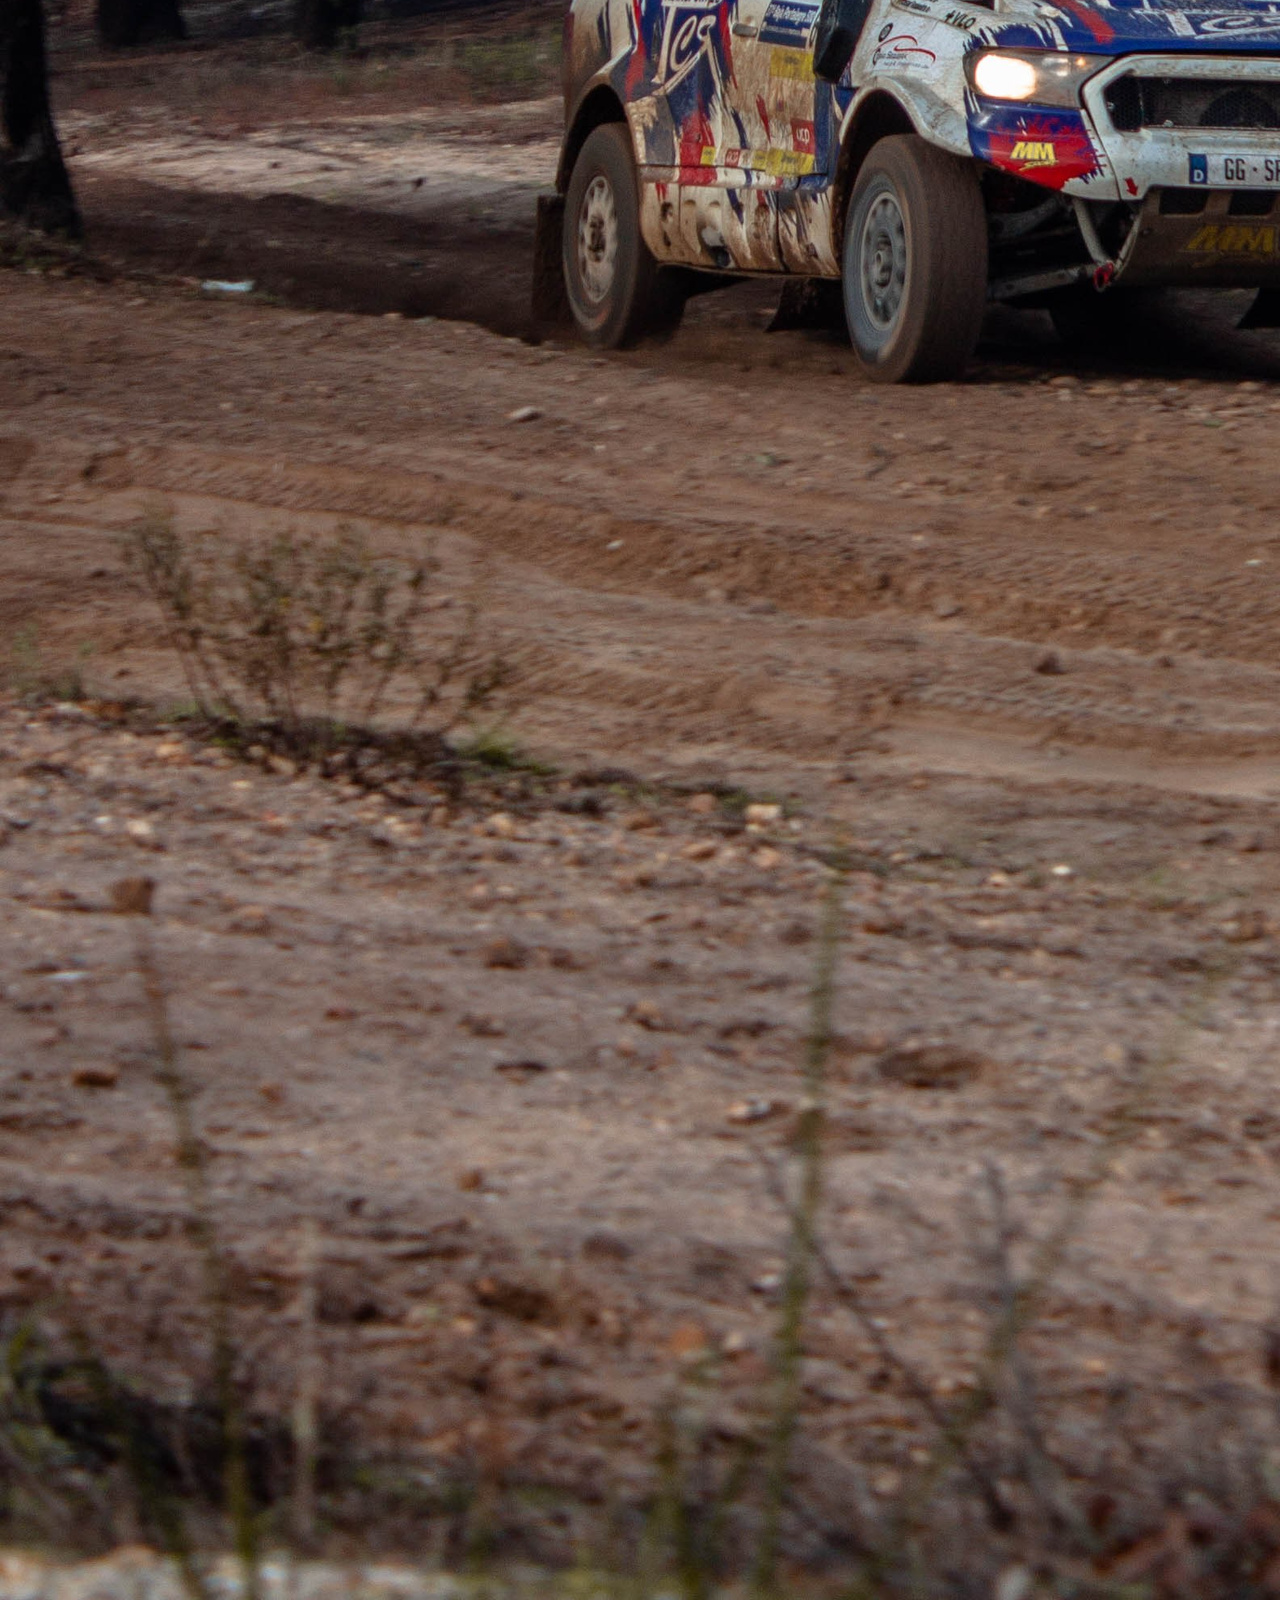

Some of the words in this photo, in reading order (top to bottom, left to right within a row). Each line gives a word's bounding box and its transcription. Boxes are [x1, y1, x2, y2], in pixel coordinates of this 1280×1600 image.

[1011, 142, 1056, 160] MM
[1193, 169, 1204, 182] D
[1224, 158, 1246, 180] GG
